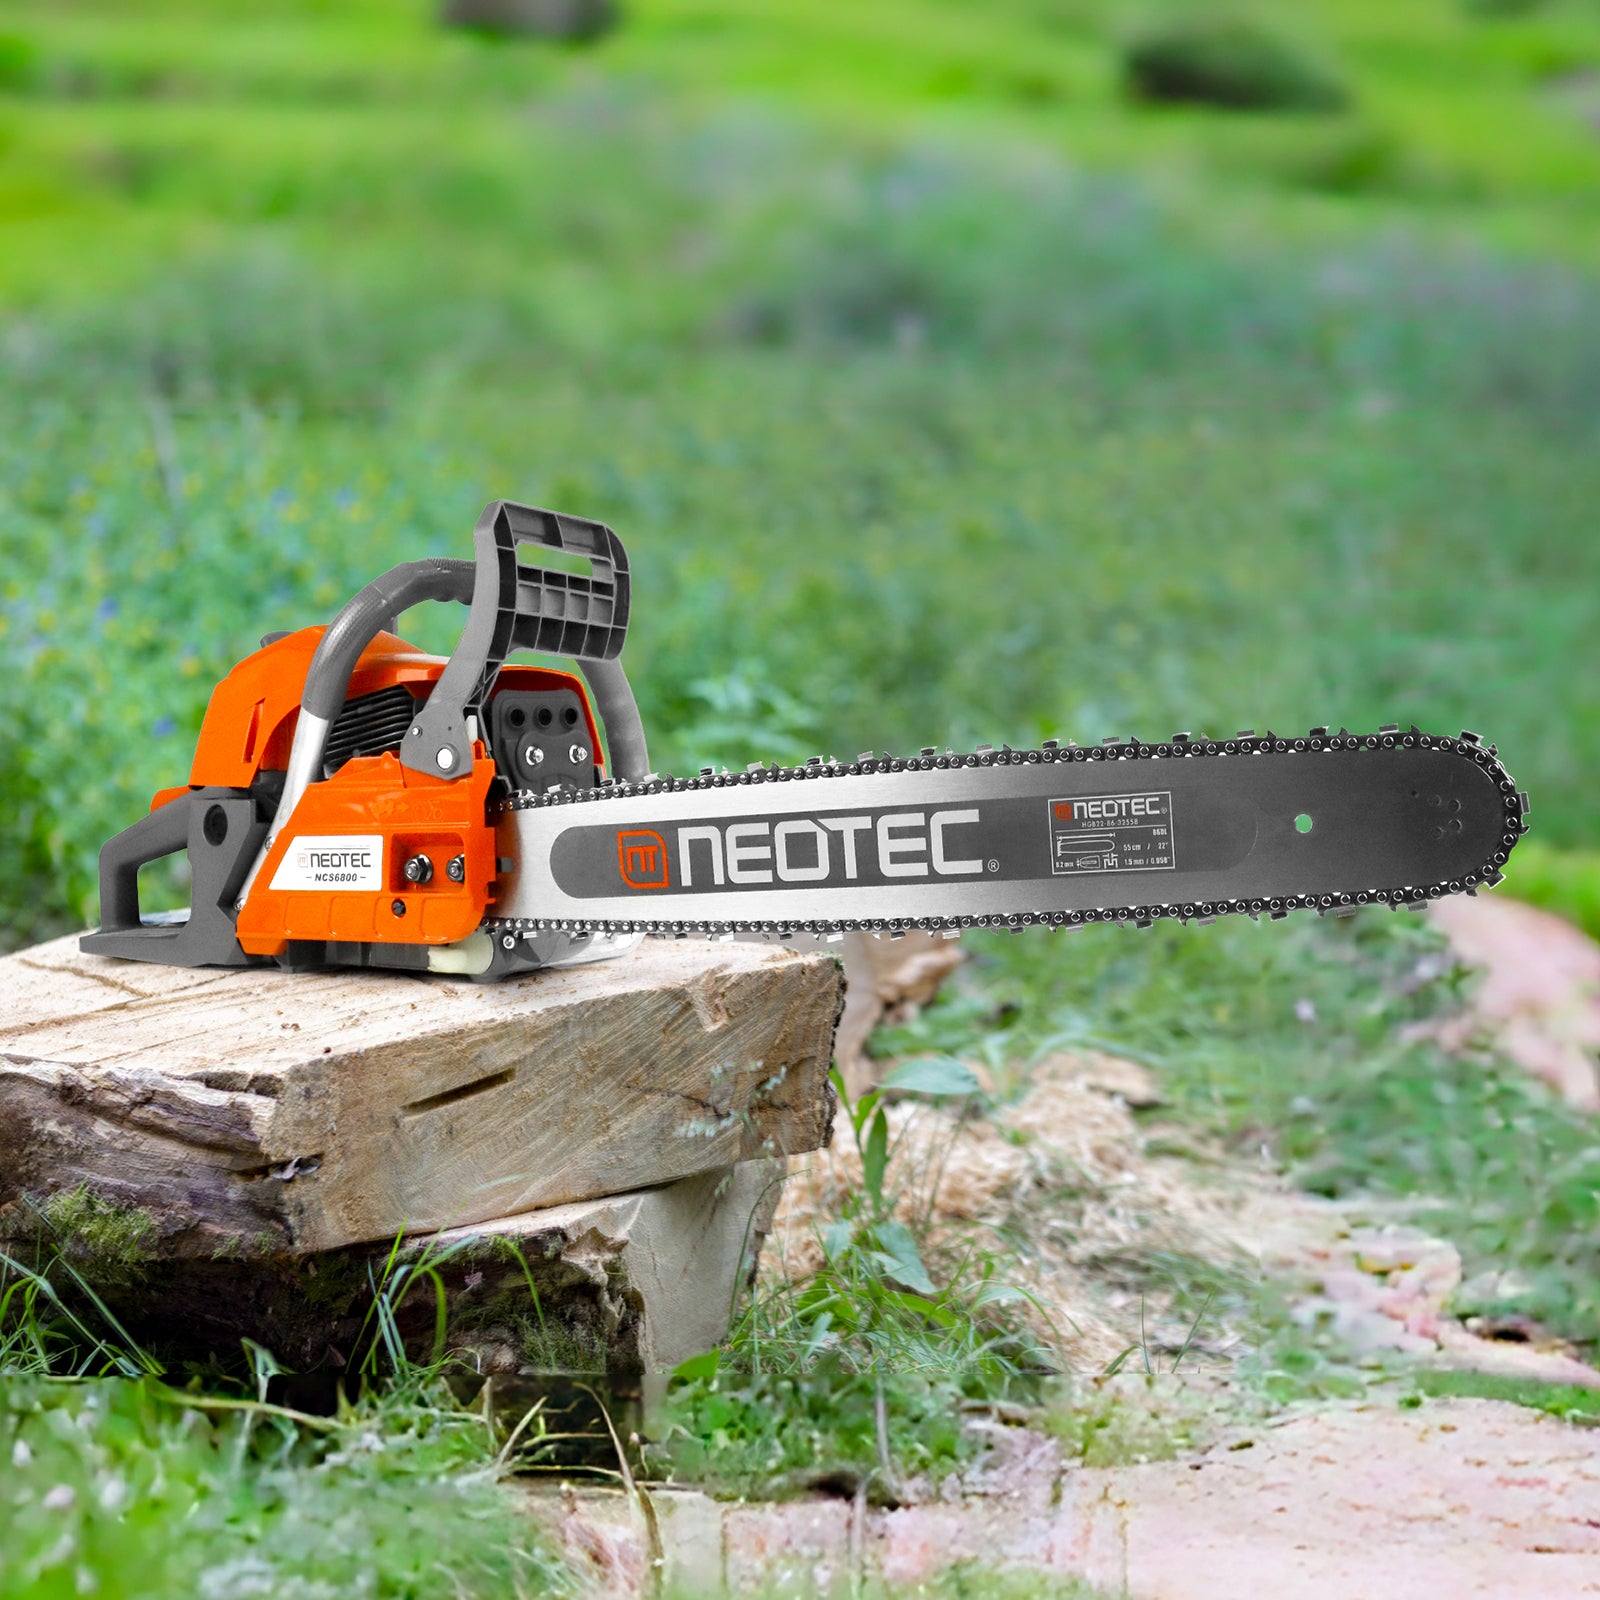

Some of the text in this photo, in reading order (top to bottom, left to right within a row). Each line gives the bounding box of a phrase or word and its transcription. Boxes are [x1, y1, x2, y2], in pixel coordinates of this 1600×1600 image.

[1073, 797, 1160, 819] NEOTEC
[677, 808, 983, 887] NEOTEC
[310, 853, 371, 868] NEOTEC
[314, 873, 358, 882] NCS6800
